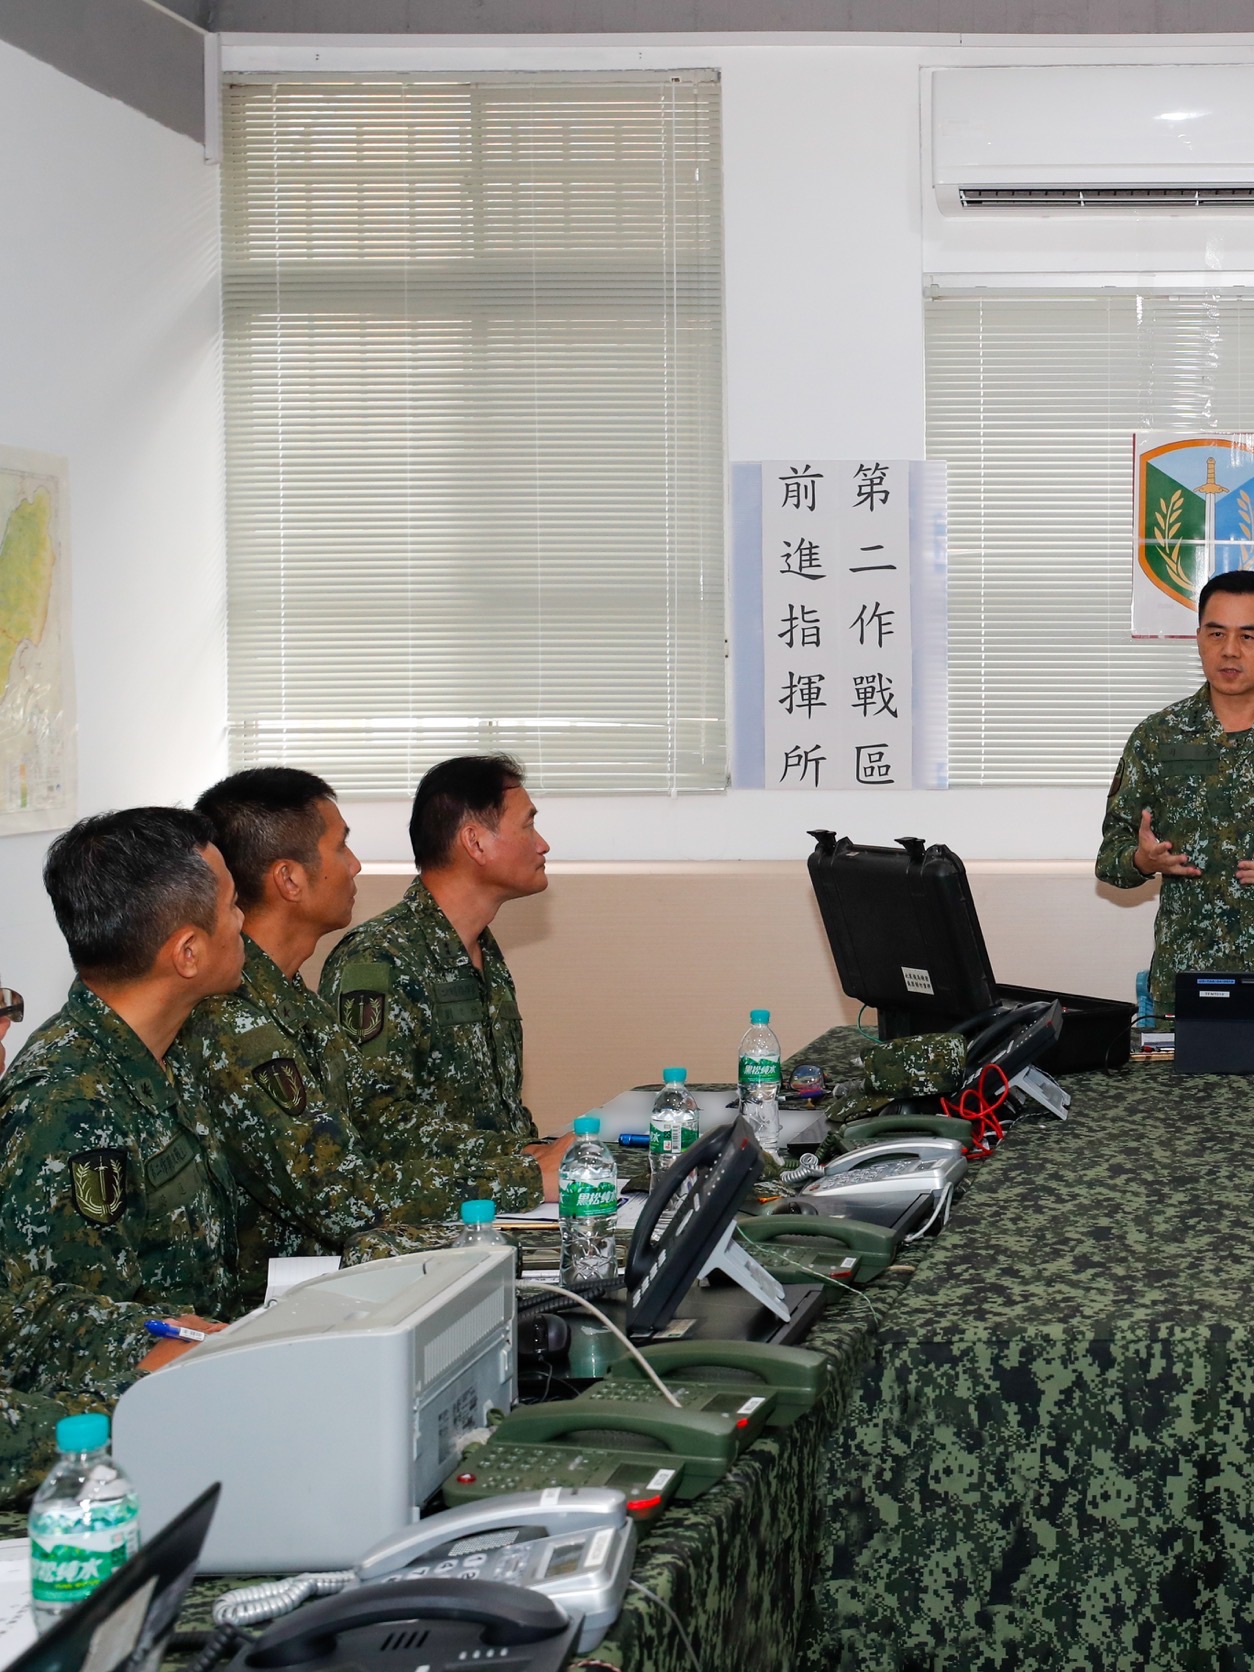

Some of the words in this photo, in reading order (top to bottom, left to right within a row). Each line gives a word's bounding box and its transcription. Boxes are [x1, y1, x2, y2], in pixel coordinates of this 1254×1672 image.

[778, 464, 827, 788] 前進指揮所
[849, 462, 898, 785] 第二作戰區
